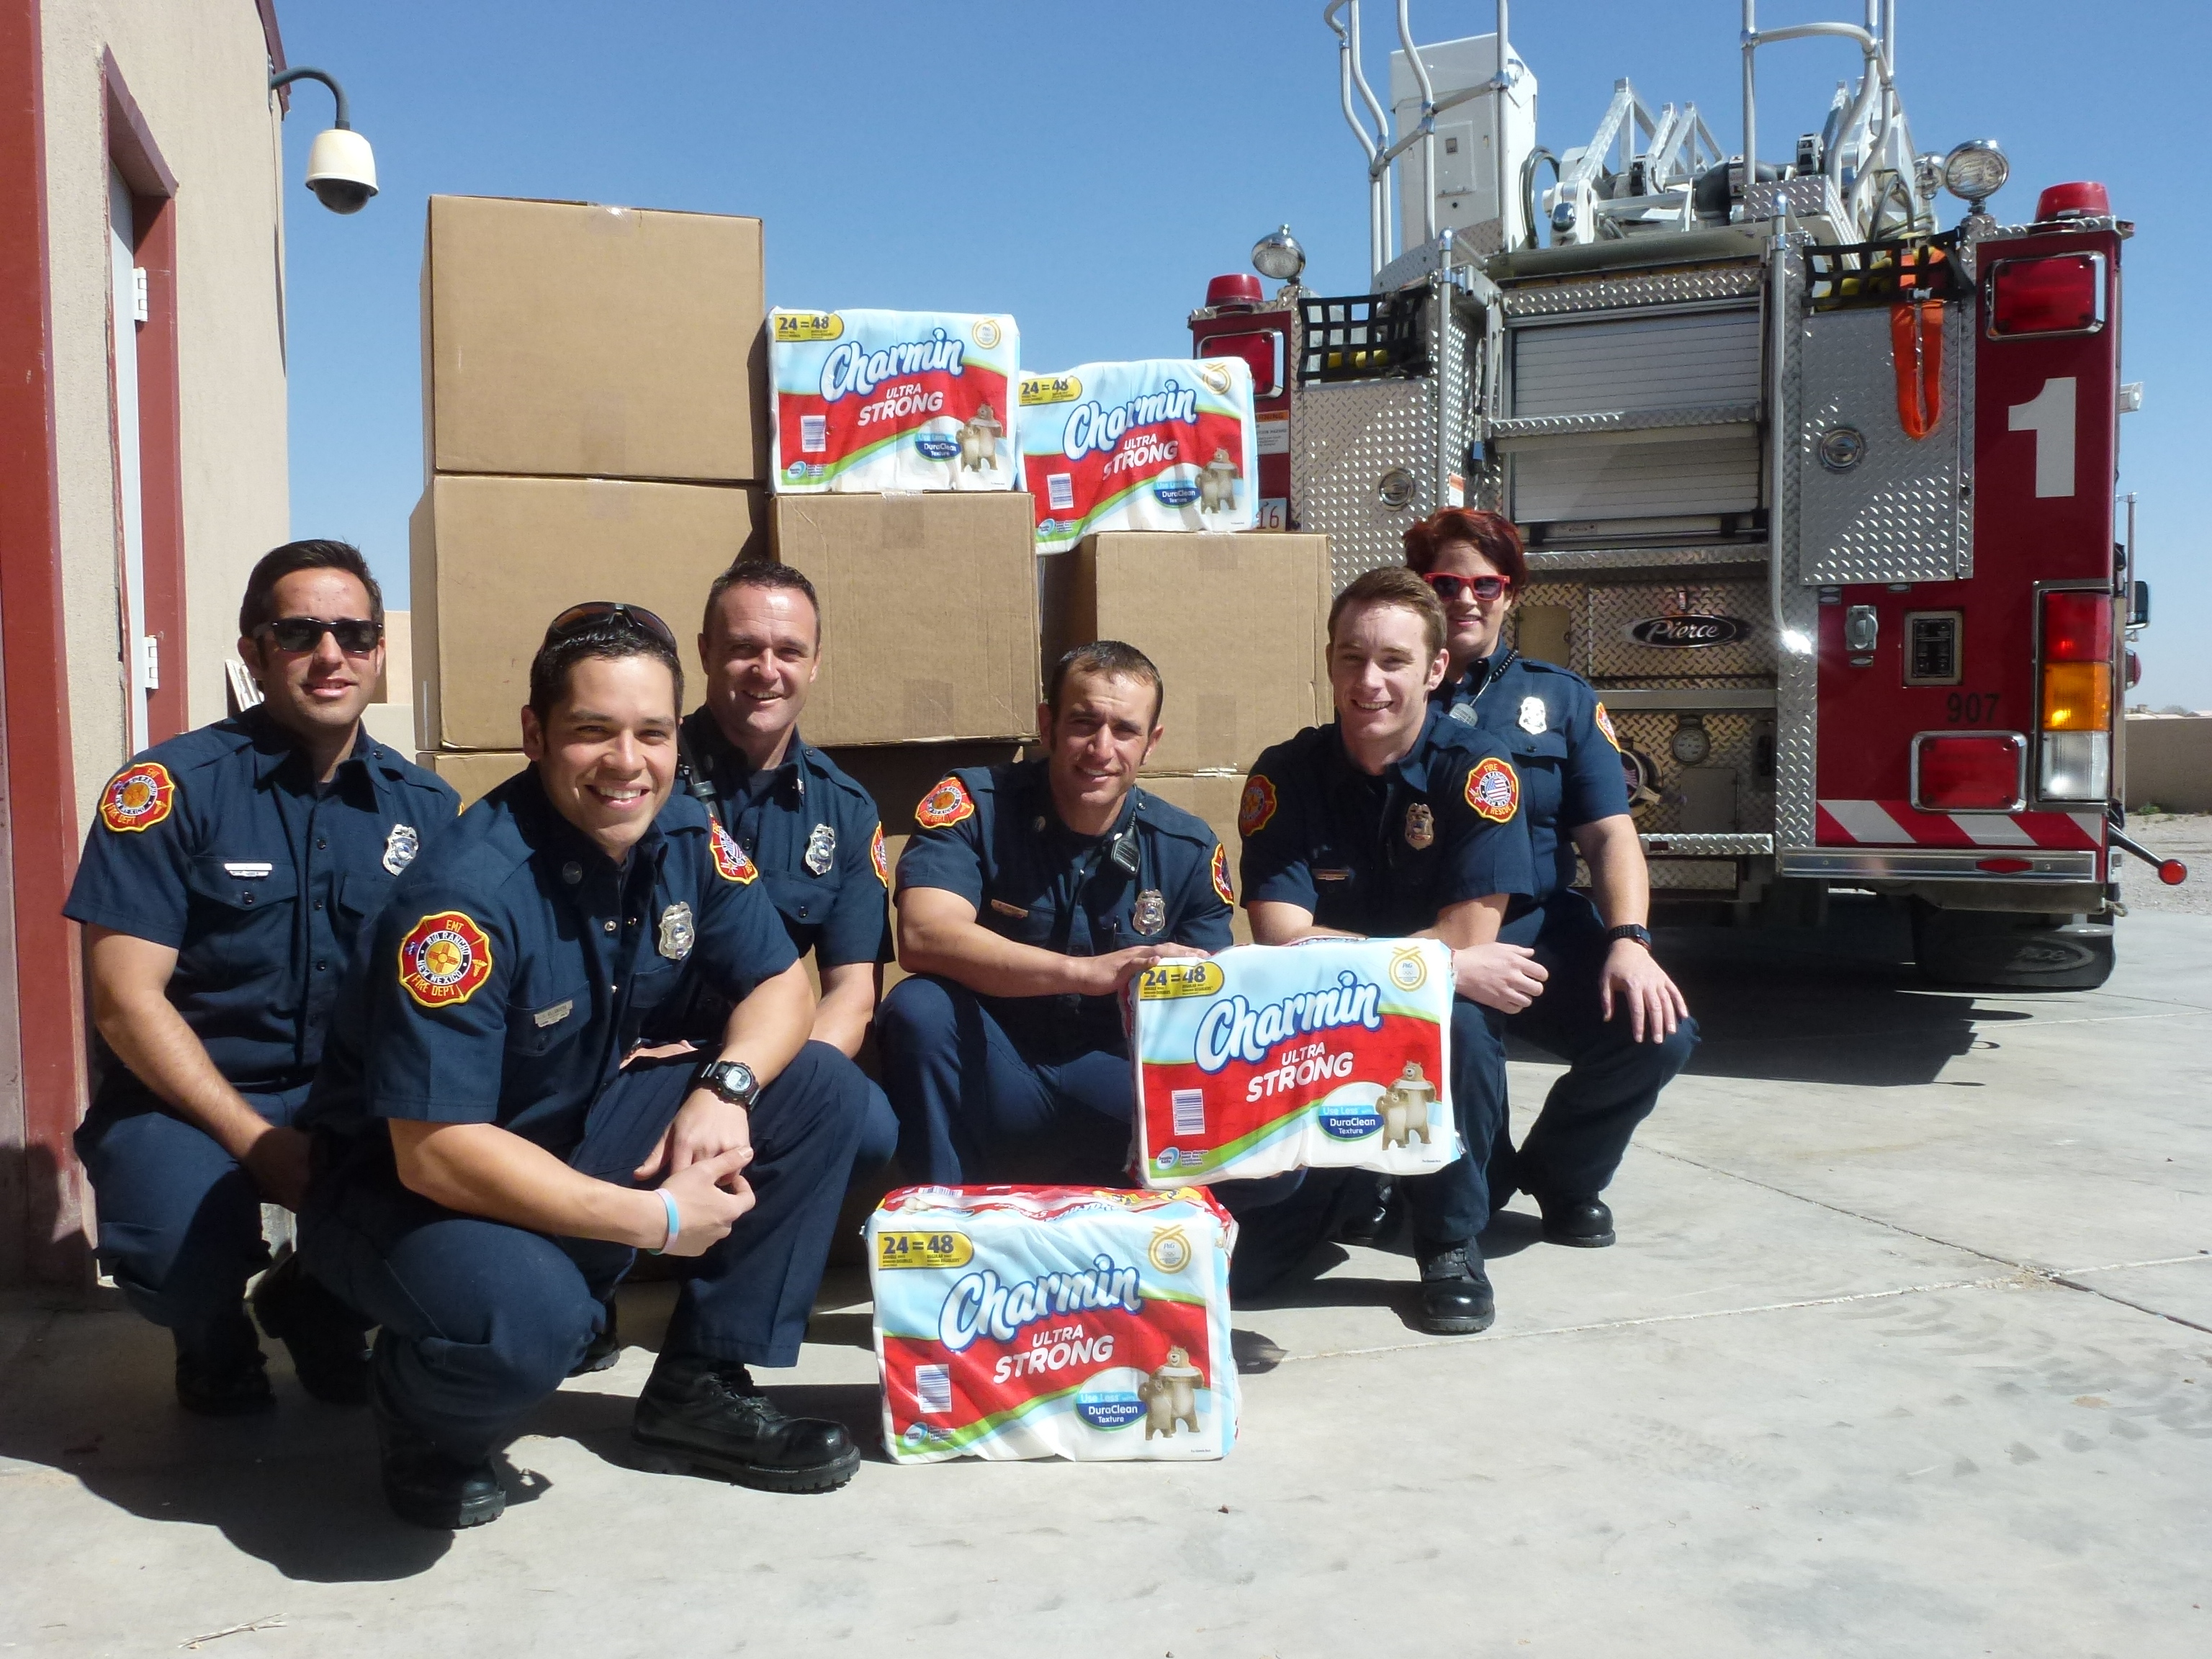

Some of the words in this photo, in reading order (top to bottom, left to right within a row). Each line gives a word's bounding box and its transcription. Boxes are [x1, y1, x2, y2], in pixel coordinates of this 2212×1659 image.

[778, 317, 798, 331] 24
[811, 316, 830, 329] 48
[820, 328, 964, 403] Charmin
[886, 383, 922, 399] ULTRA
[858, 391, 944, 426] STRONG
[1063, 379, 1198, 462] Charmin
[924, 443, 957, 451] DuraClean
[1123, 433, 1157, 451] ULTRA
[2008, 377, 2077, 498] 1
[1102, 440, 1179, 481] STRONG
[1645, 619, 1720, 642] Pierce
[1947, 693, 2000, 722] 907
[1483, 763, 1498, 773] FIRE
[1490, 804, 1511, 815] RESCUE
[446, 920, 464, 933] EMT
[426, 934, 440, 945] RIO
[442, 932, 470, 956] RANCHO
[418, 960, 429, 976] NEW
[430, 970, 462, 984] MEXICO
[1145, 969, 1167, 986] 24
[1182, 966, 1206, 983] 48
[411, 974, 431, 993] FIRE
[432, 985, 455, 997] DEPT
[1194, 969, 1382, 1074] Charmin
[1282, 1041, 1326, 1066] ULTRA
[1246, 1052, 1354, 1102] STRONG
[1329, 1118, 1376, 1127] DuraClean
[884, 1236, 909, 1254] 24
[927, 1234, 954, 1254] 48
[938, 1253, 1143, 1352] Charmin
[1031, 1324, 1084, 1348] ULTRA
[993, 1335, 1115, 1384] STRONG
[1088, 1404, 1138, 1415] DuraClean
